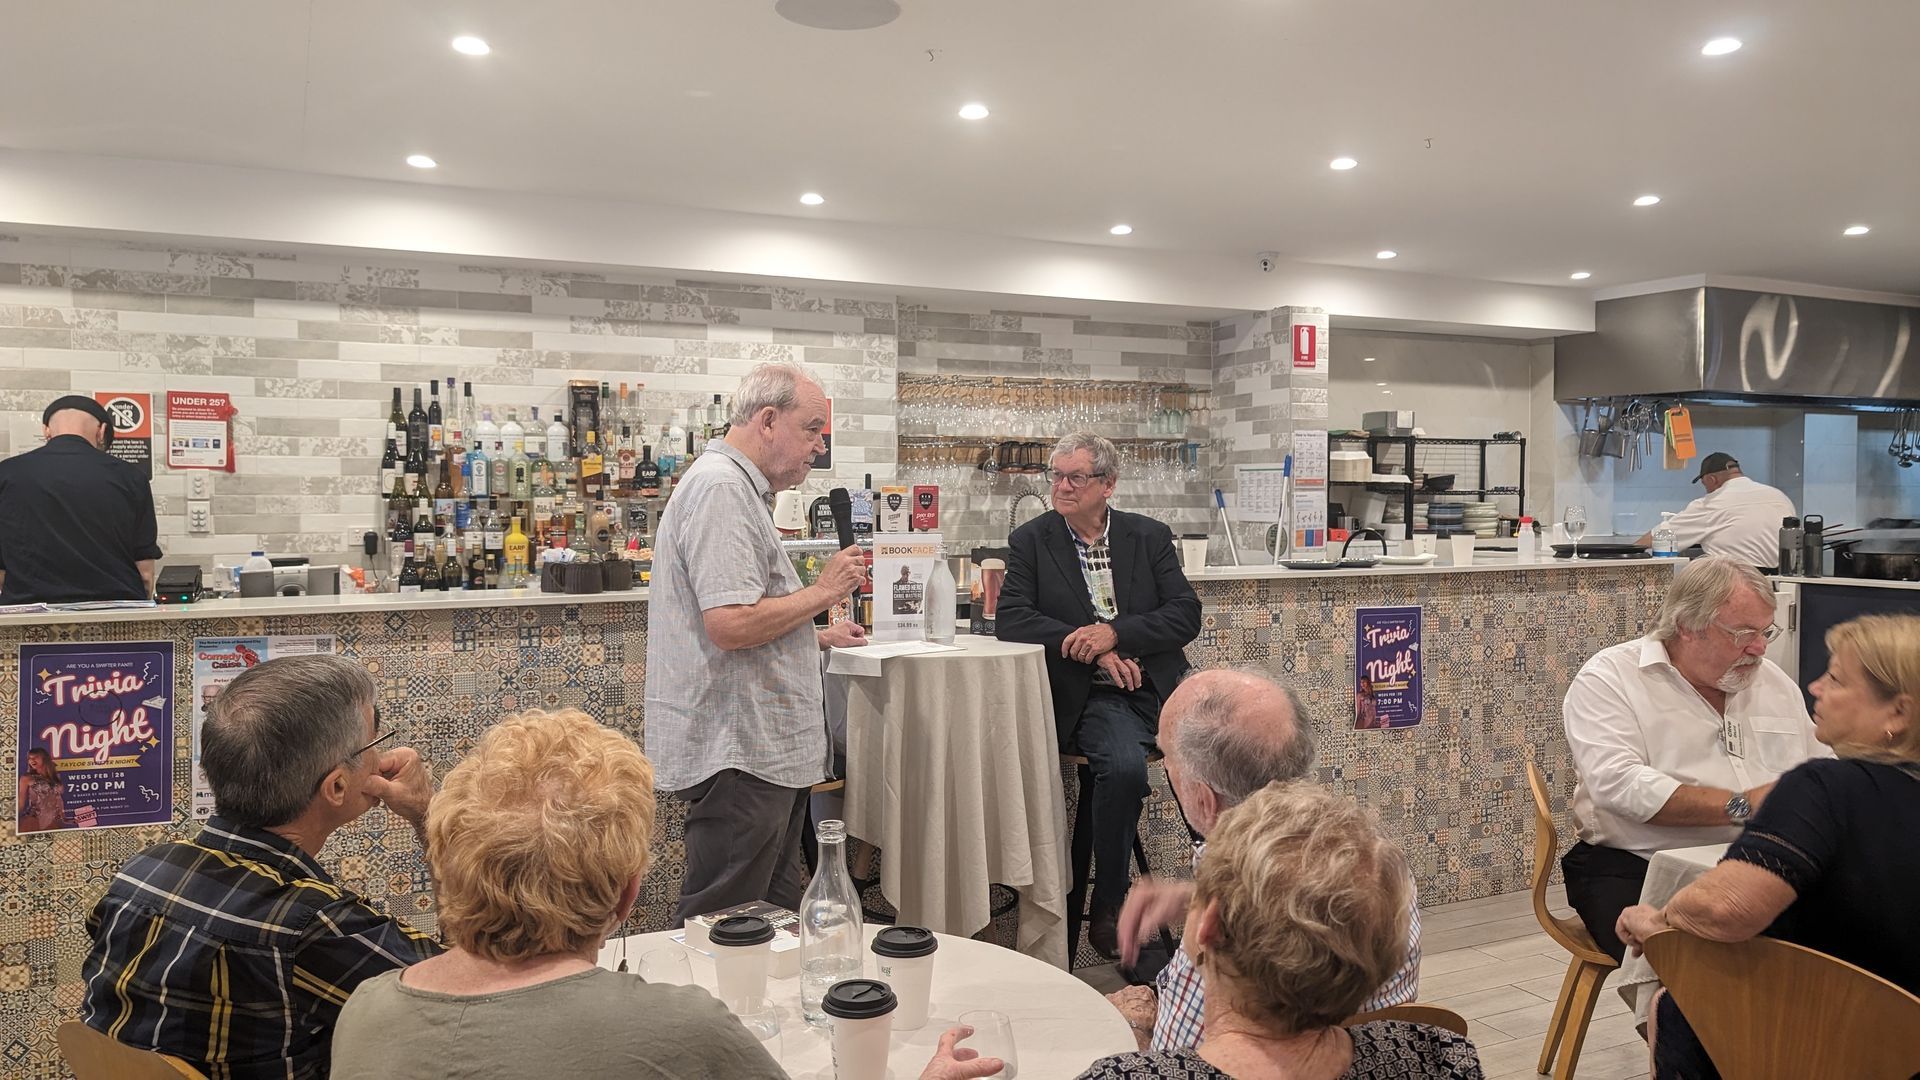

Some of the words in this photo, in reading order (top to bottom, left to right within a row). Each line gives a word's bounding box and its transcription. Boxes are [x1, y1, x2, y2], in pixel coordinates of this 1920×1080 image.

[172, 396, 207, 406] UNDER
[209, 398, 226, 406] 25?
[112, 408, 134, 426] 18
[1367, 626, 1410, 648] Trivia
[199, 652, 241, 662] Comedy
[1366, 650, 1414, 685] Night
[43, 671, 143, 705] Trivia
[42, 708, 153, 762] Night
[68, 782, 99, 792] 7:00
[105, 781, 125, 790] PM
